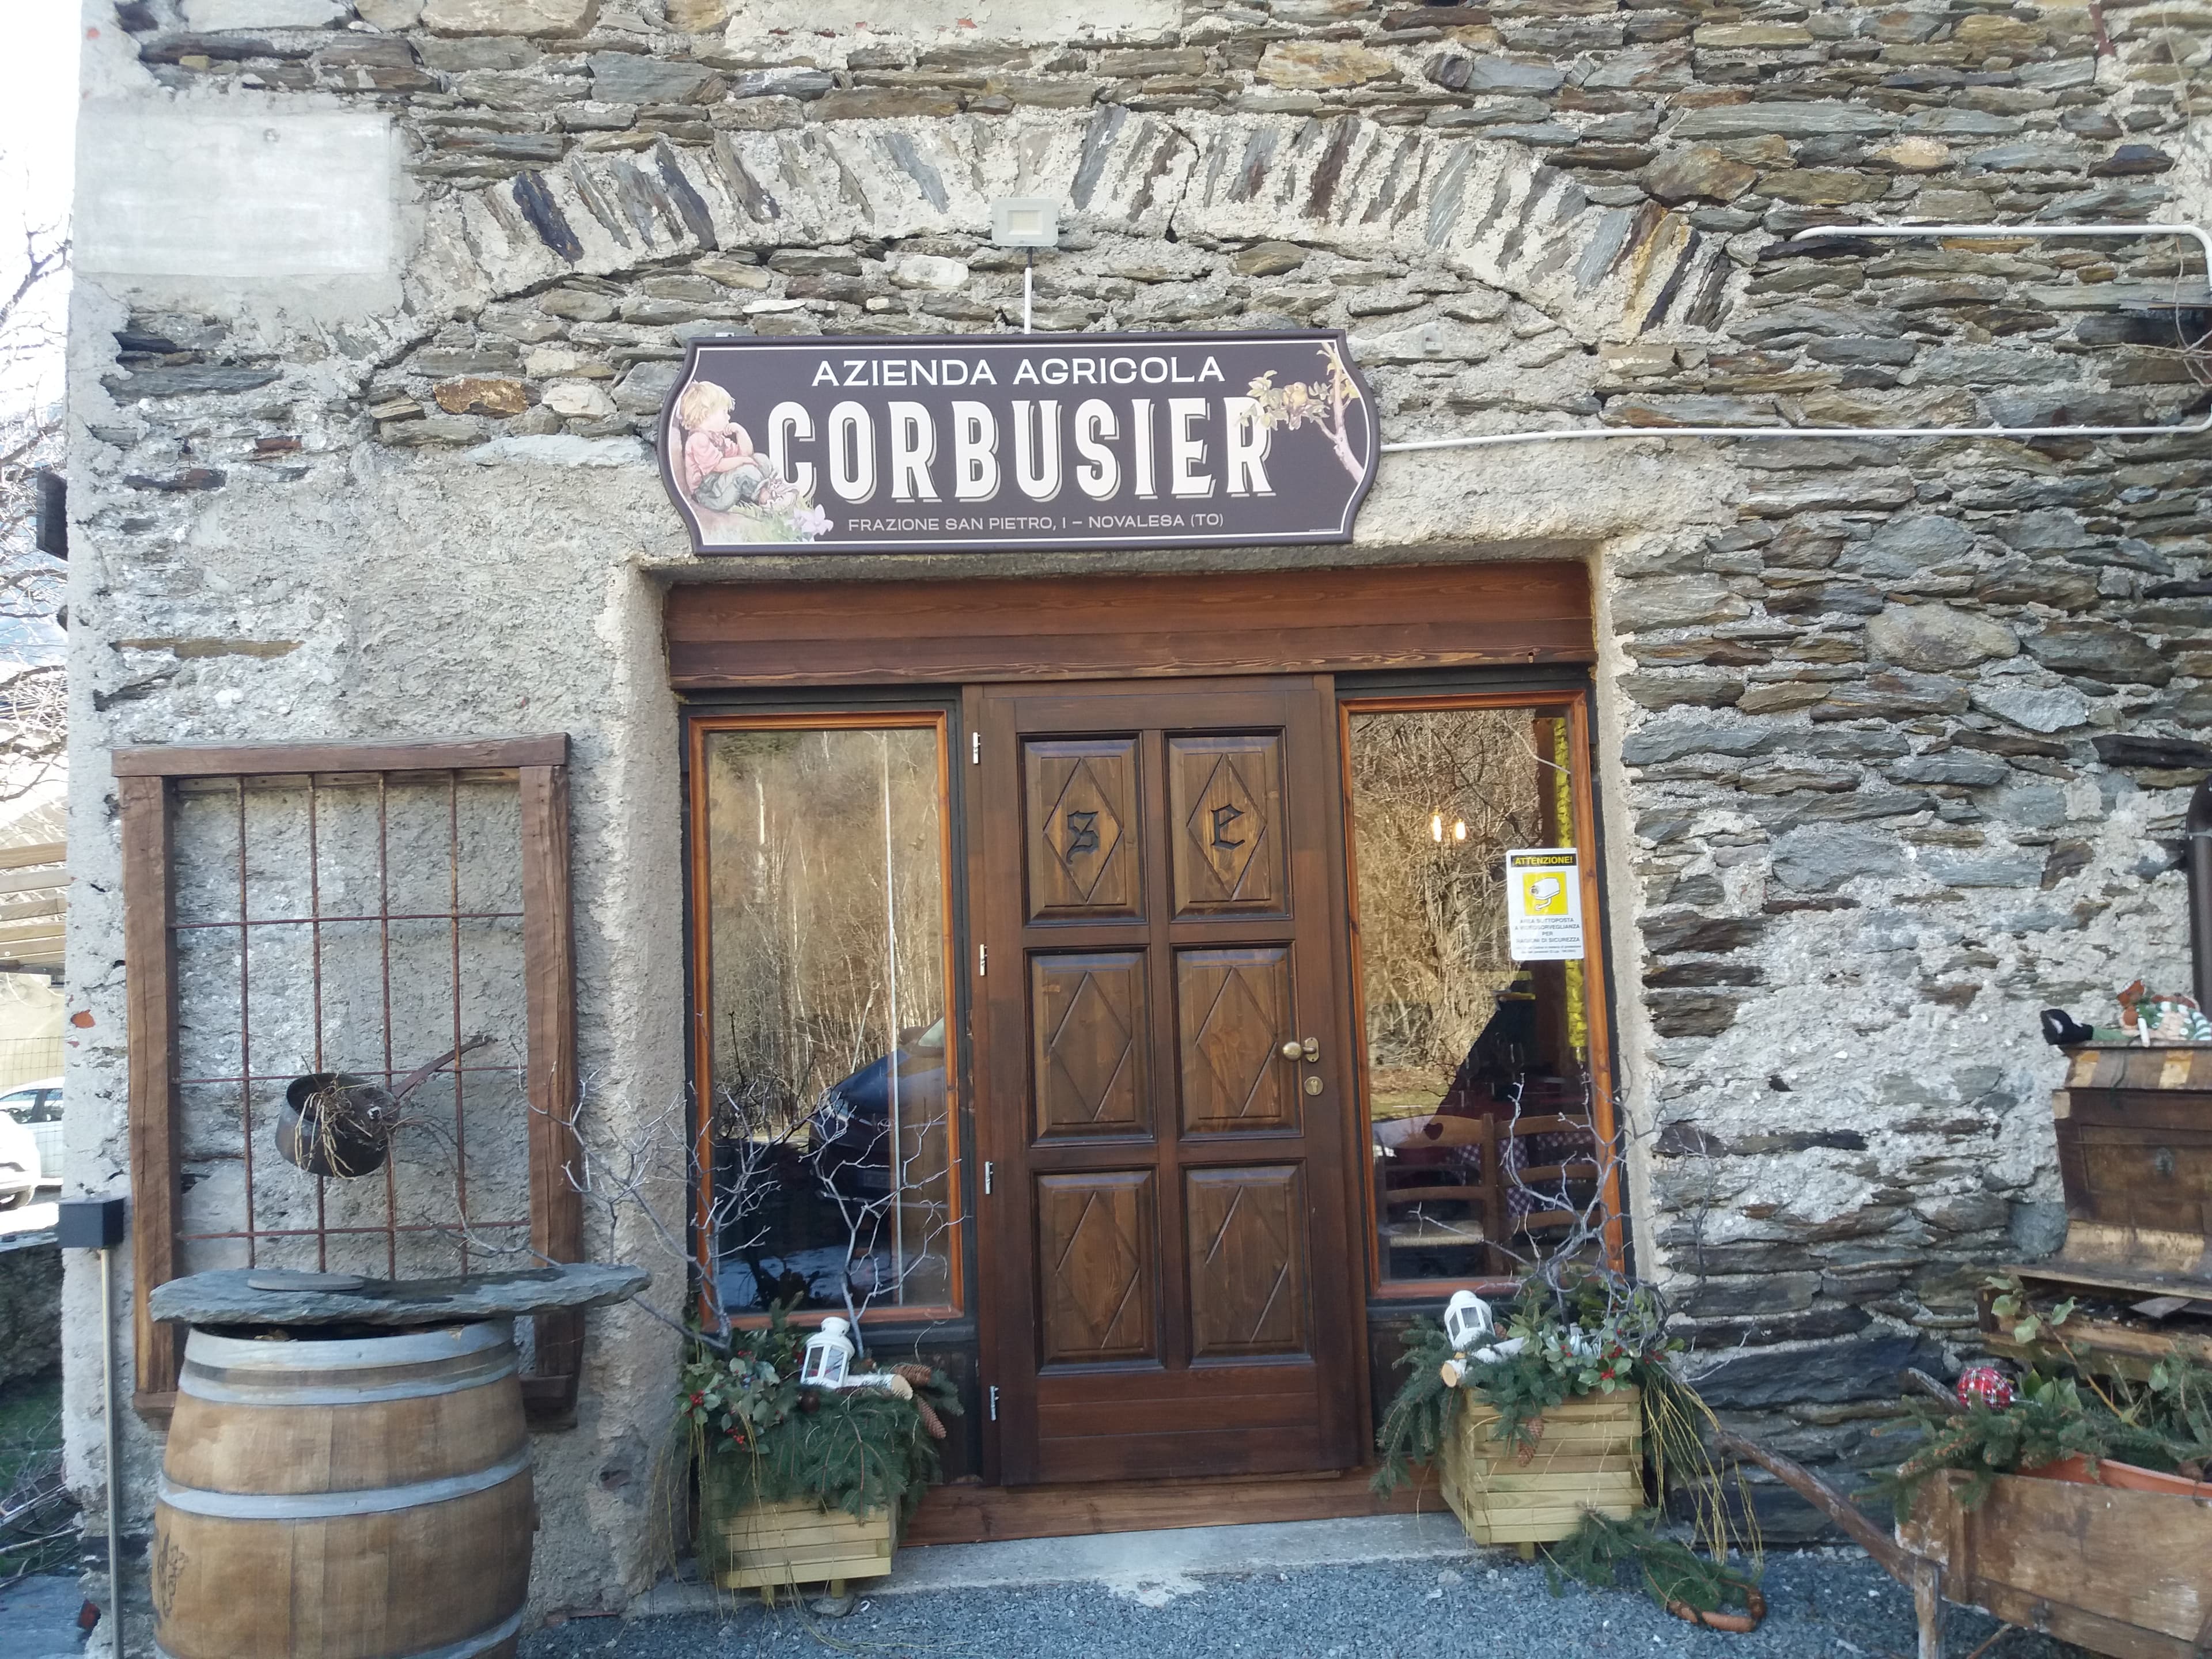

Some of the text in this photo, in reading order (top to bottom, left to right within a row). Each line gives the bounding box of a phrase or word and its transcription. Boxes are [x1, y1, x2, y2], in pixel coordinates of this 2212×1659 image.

[811, 355, 1226, 387] AZIENDA AGRICOLA
[767, 397, 1277, 505] CORBUSIER
[848, 518, 940, 532] FRAZIONE
[945, 518, 983, 531] SAN
[988, 517, 1056, 531] PIETRO,
[1089, 514, 1185, 528] NOVALESA
[1191, 513, 1224, 527] (TO)
[1515, 855, 1573, 865] ATTENZIONE!
